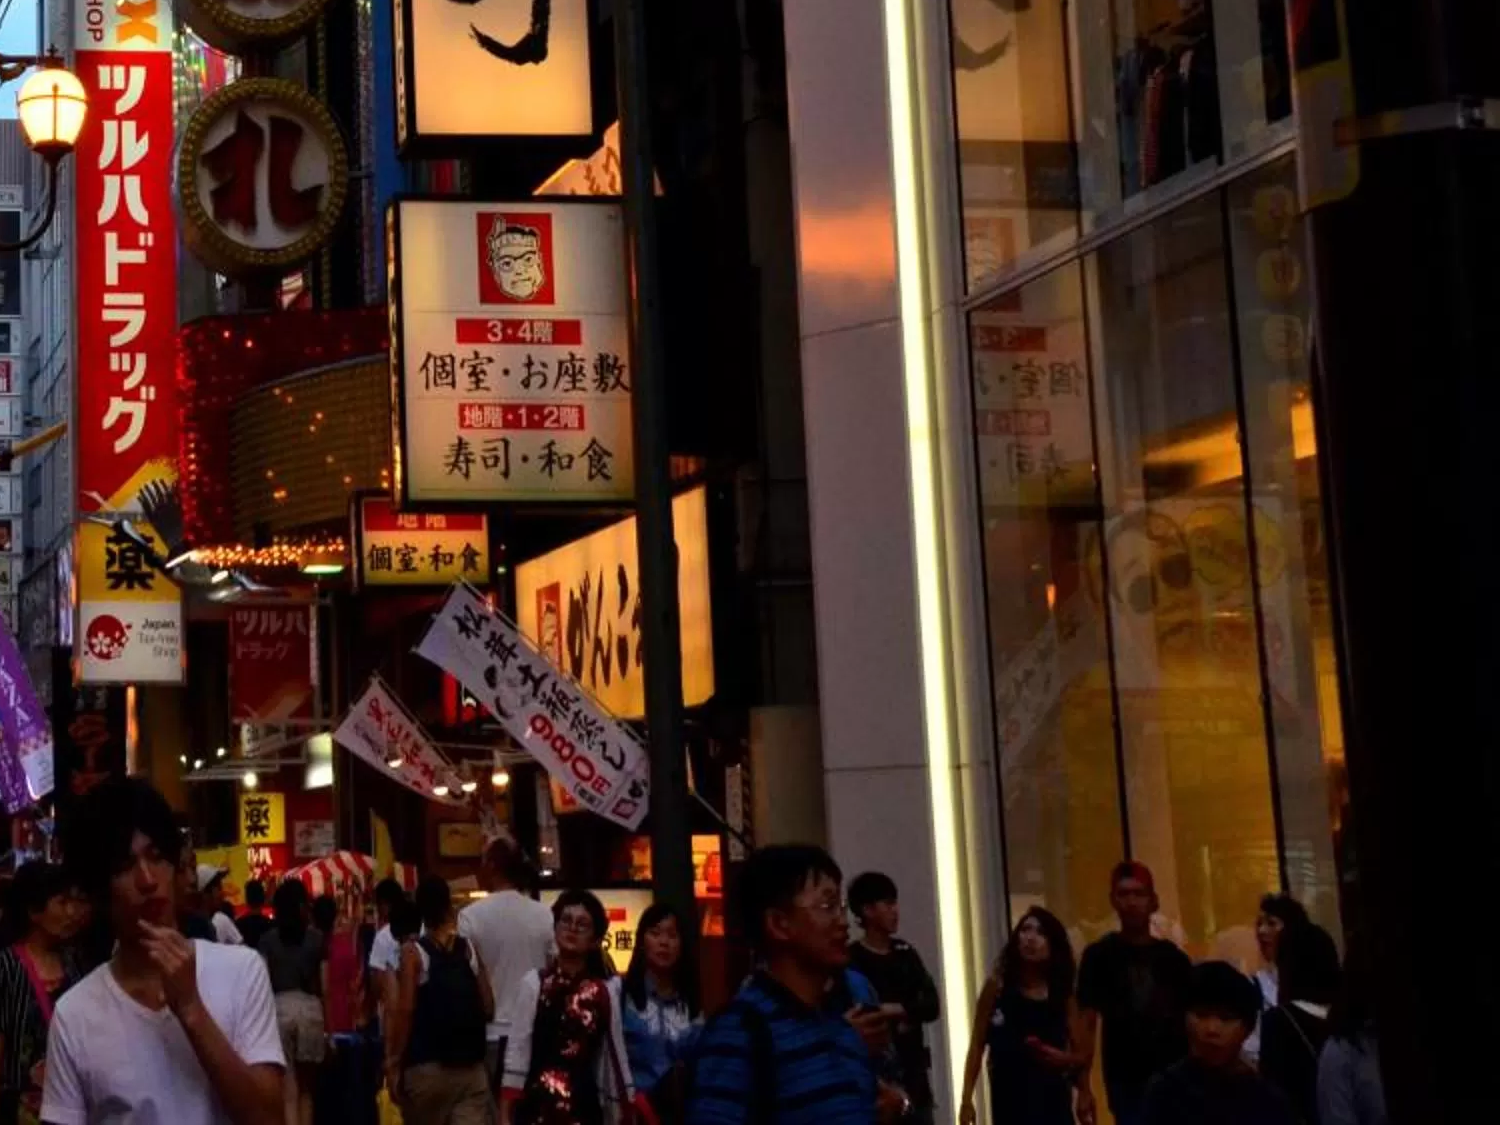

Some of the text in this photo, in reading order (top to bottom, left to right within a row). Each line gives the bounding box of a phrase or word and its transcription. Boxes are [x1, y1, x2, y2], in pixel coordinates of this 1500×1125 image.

[96, 64, 156, 456] ツルハドラッグ
[419, 350, 633, 394] 個室・お座敷
[444, 437, 614, 482] 寿司・和食
[105, 518, 156, 591] 薬
[367, 543, 483, 573] 個室・和食
[235, 610, 308, 636] ツルハ
[529, 713, 613, 795] 980円
